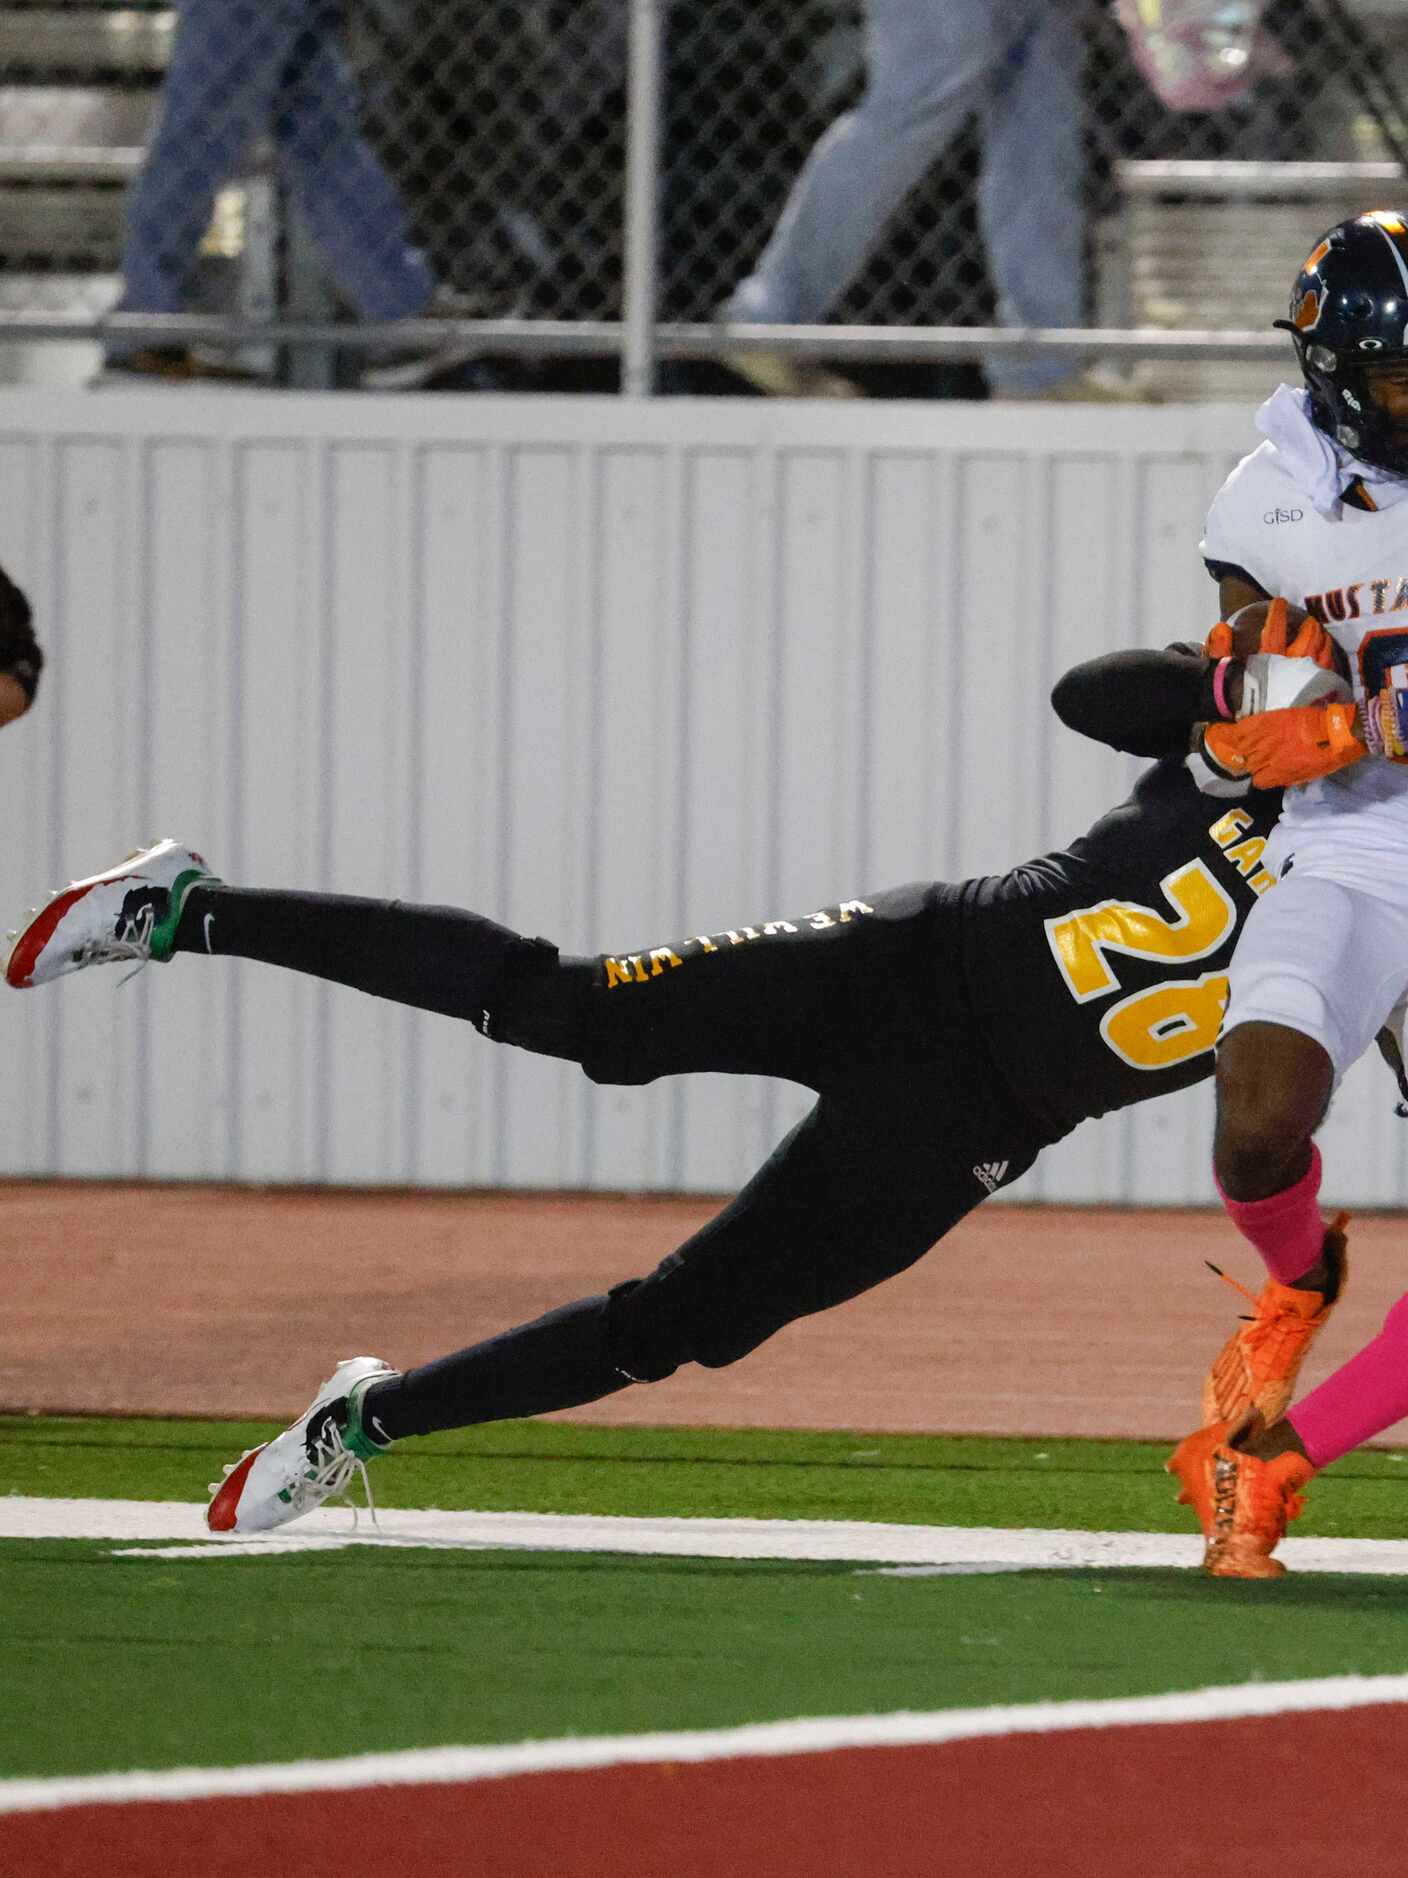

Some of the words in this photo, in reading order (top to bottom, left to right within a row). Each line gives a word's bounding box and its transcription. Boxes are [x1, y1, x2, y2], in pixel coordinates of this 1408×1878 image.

[801, 899, 874, 930] WE
[683, 920, 798, 953] WILL
[604, 947, 684, 989] WIN
